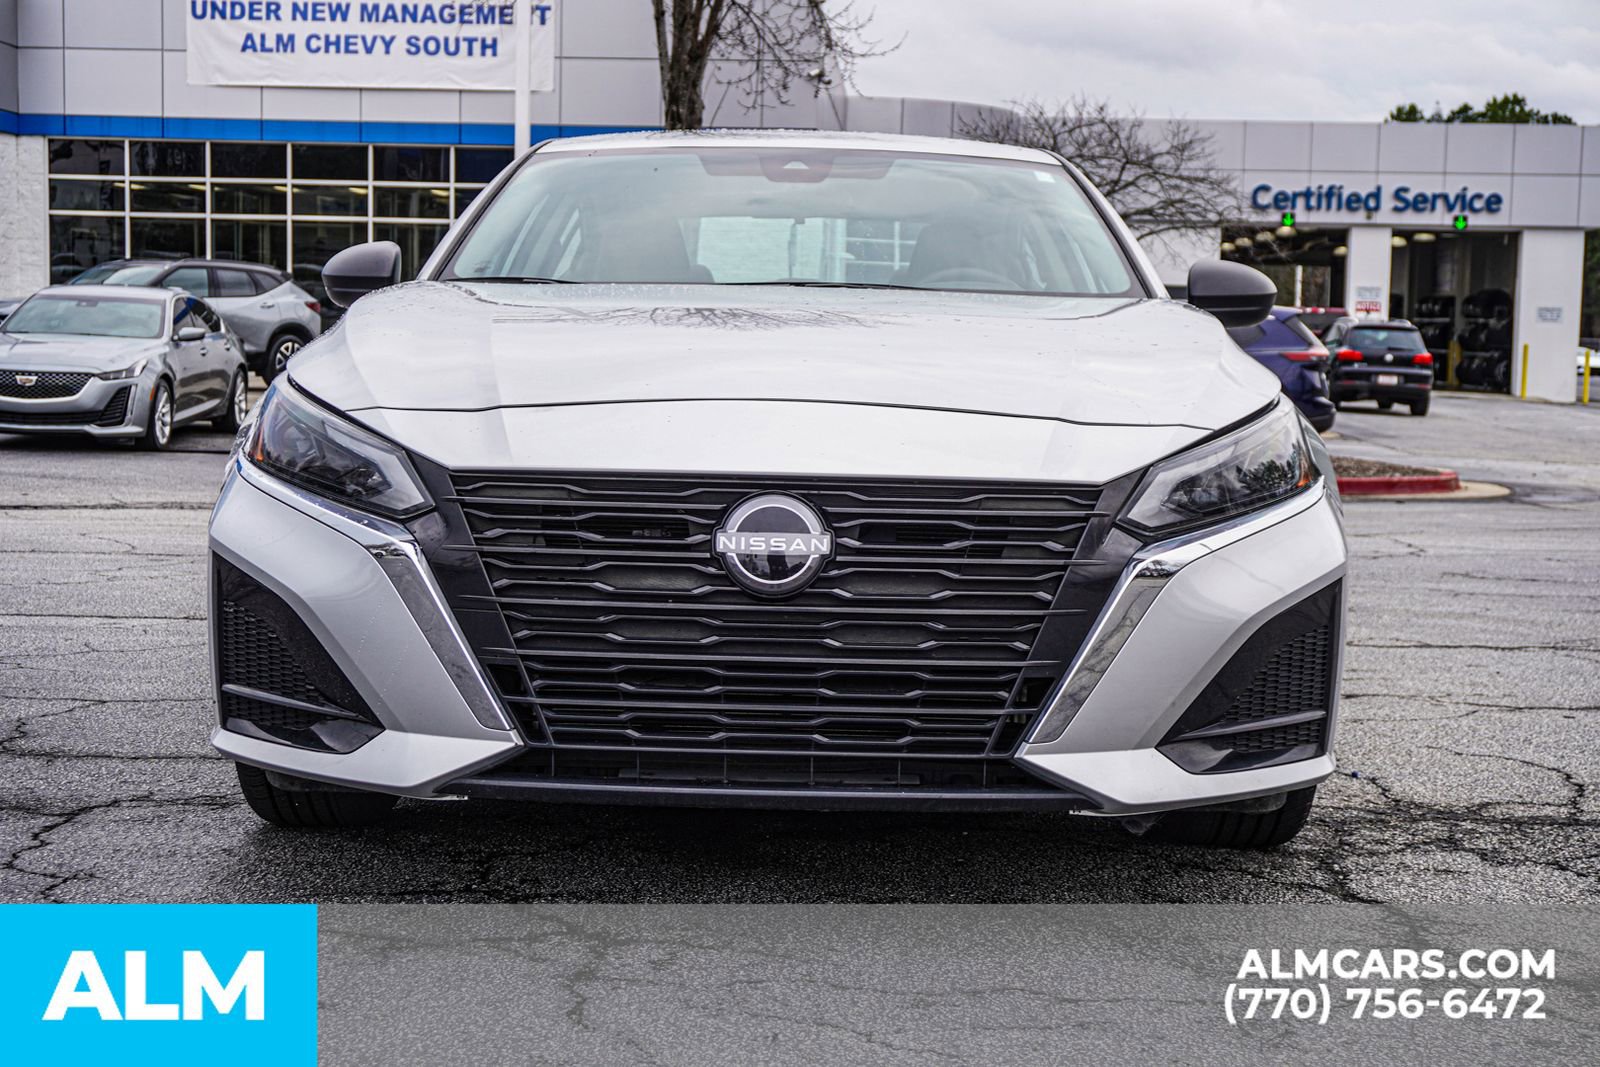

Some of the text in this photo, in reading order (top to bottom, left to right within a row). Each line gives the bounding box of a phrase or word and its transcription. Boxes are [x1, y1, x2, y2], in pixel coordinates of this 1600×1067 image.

[191, 0, 551, 25] UNDER NEW MANAGEMET
[241, 32, 499, 57] ALM CHEVY SOUTH
[1251, 184, 1503, 213] Certified Service
[719, 535, 828, 552] NISSAN
